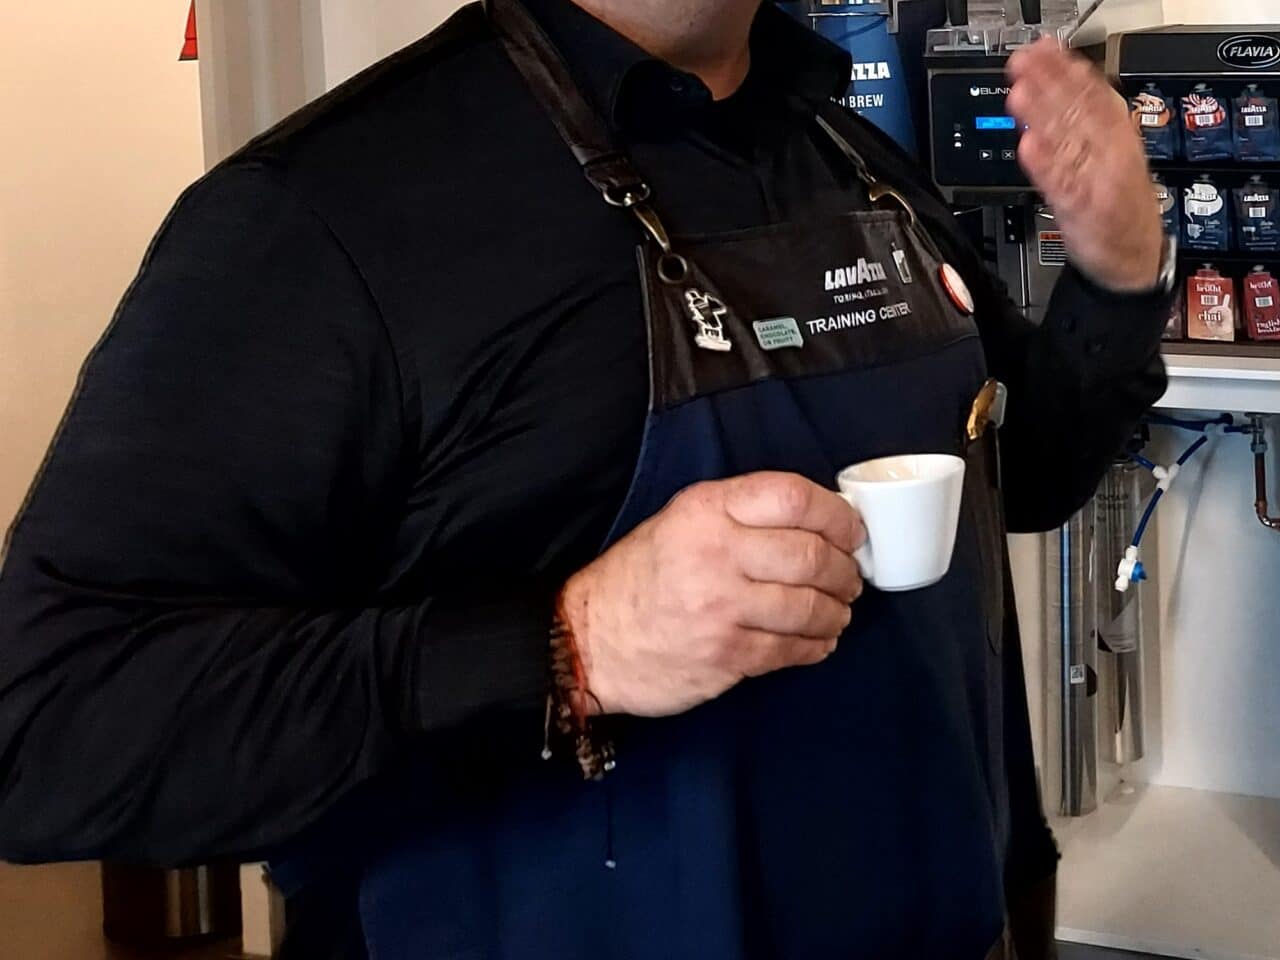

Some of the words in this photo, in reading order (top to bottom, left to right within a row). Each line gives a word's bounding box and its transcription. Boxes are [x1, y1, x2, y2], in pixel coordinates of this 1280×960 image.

[1229, 46, 1274, 57] FLAVIA
[851, 61, 891, 81] ZZA
[849, 93, 884, 109] BREW
[805, 309, 877, 336] TRAINING
